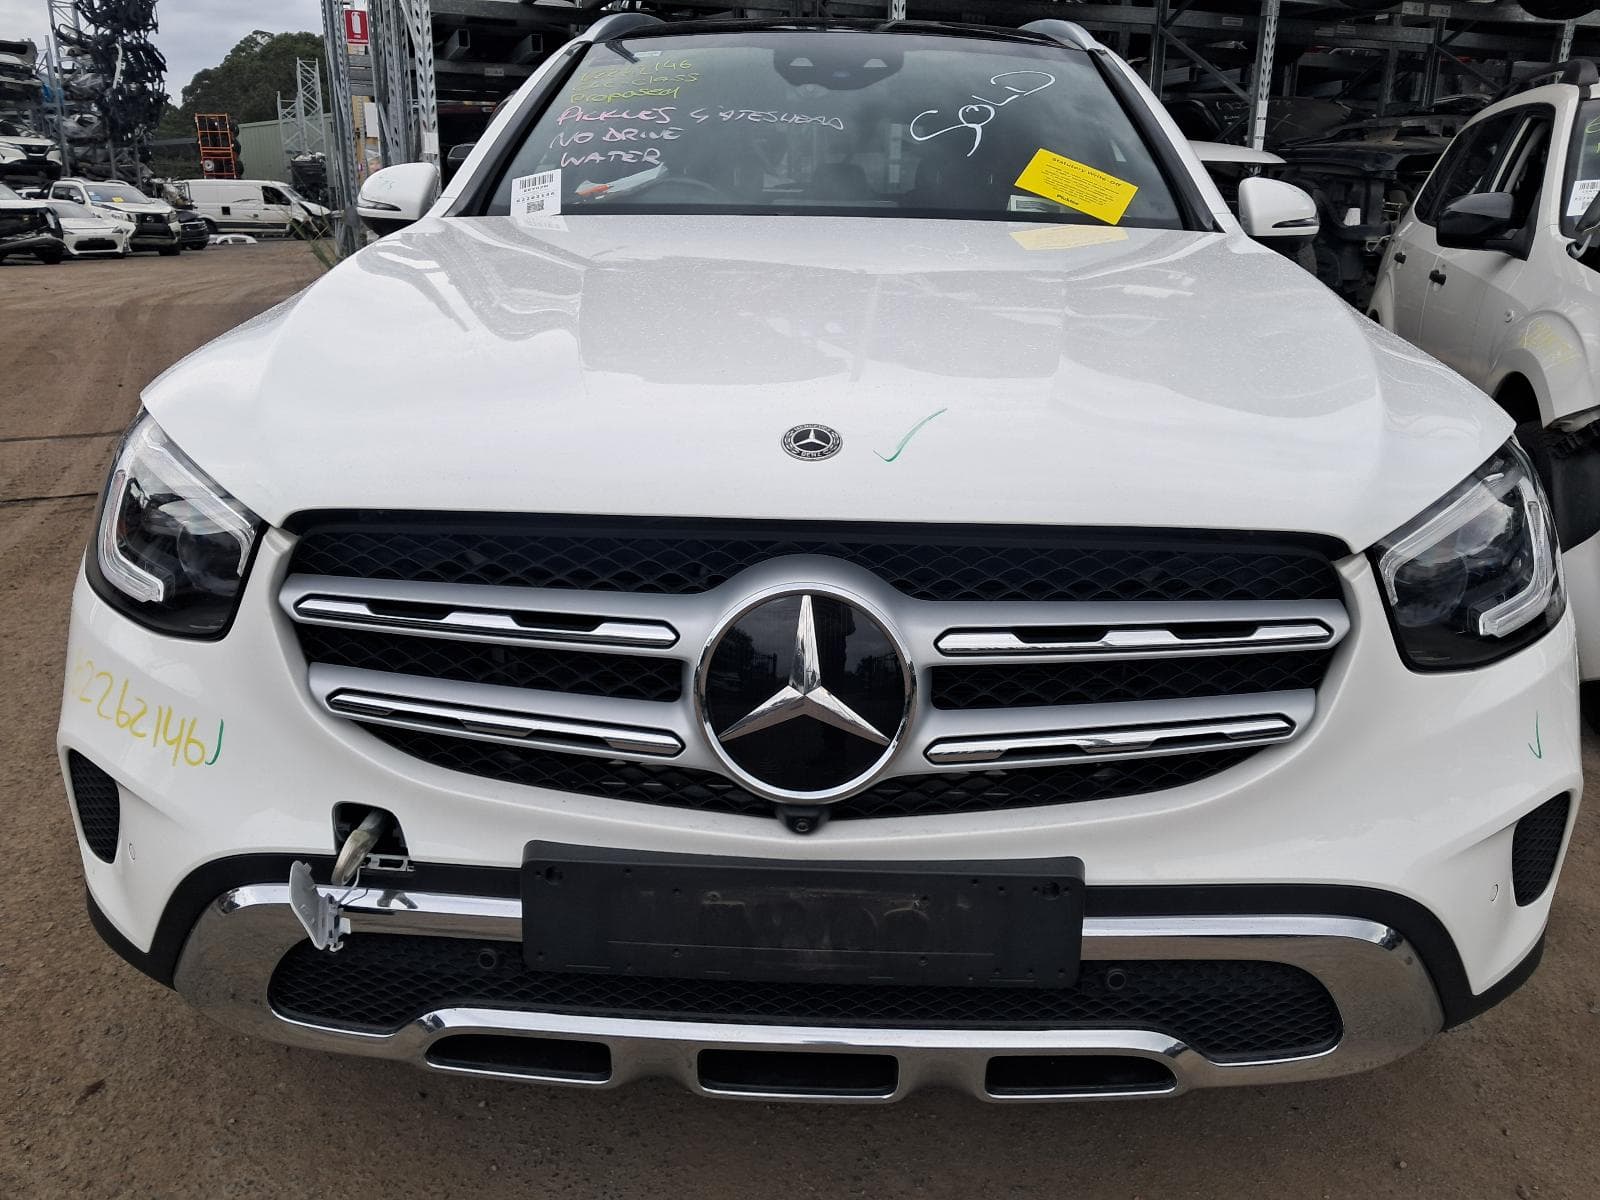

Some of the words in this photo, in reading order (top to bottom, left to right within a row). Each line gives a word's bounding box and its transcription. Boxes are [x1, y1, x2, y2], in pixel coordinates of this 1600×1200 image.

[556, 106, 676, 125] PICKLES
[549, 128, 594, 149] NO
[559, 147, 662, 168] WATER
